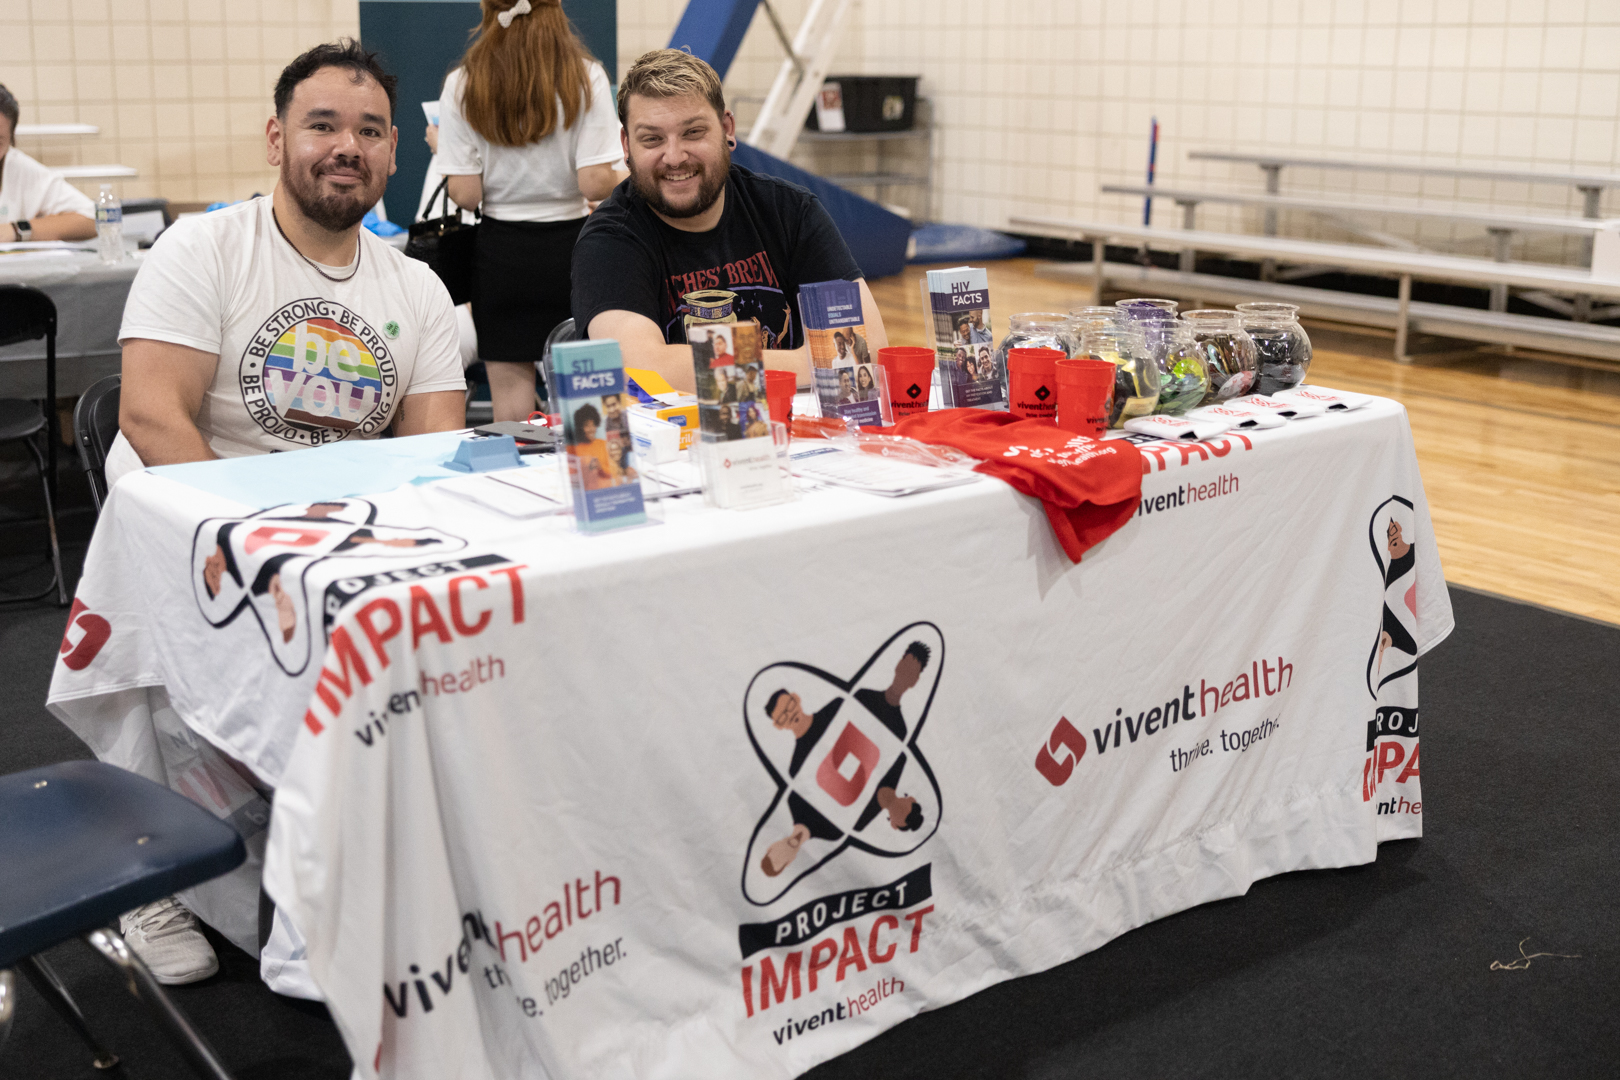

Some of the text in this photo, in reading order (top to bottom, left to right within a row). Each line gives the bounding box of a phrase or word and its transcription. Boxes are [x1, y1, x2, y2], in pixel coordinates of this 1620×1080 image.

[951, 281, 970, 293] HIV
[952, 293, 983, 307] FACTS
[249, 301, 330, 359] BE STRONG
[293, 321, 361, 382] be
[340, 310, 360, 332] BE
[359, 327, 395, 387] PROUD
[268, 369, 376, 422] you
[571, 358, 595, 374] STI
[571, 371, 616, 391] FACTS
[242, 374, 298, 440] BE PROUD
[310, 401, 391, 445] BE SONG
[1138, 473, 1239, 517] iventhealth
[325, 560, 469, 625] ROJECT
[304, 563, 532, 737] IMPACT
[354, 654, 505, 747] vienhealth
[1092, 656, 1294, 755] viventhealth
[774, 881, 908, 944] PROJECT
[543, 937, 628, 1007] together.
[741, 904, 935, 1018] IMPACT
[772, 976, 905, 1046] viventhealth
